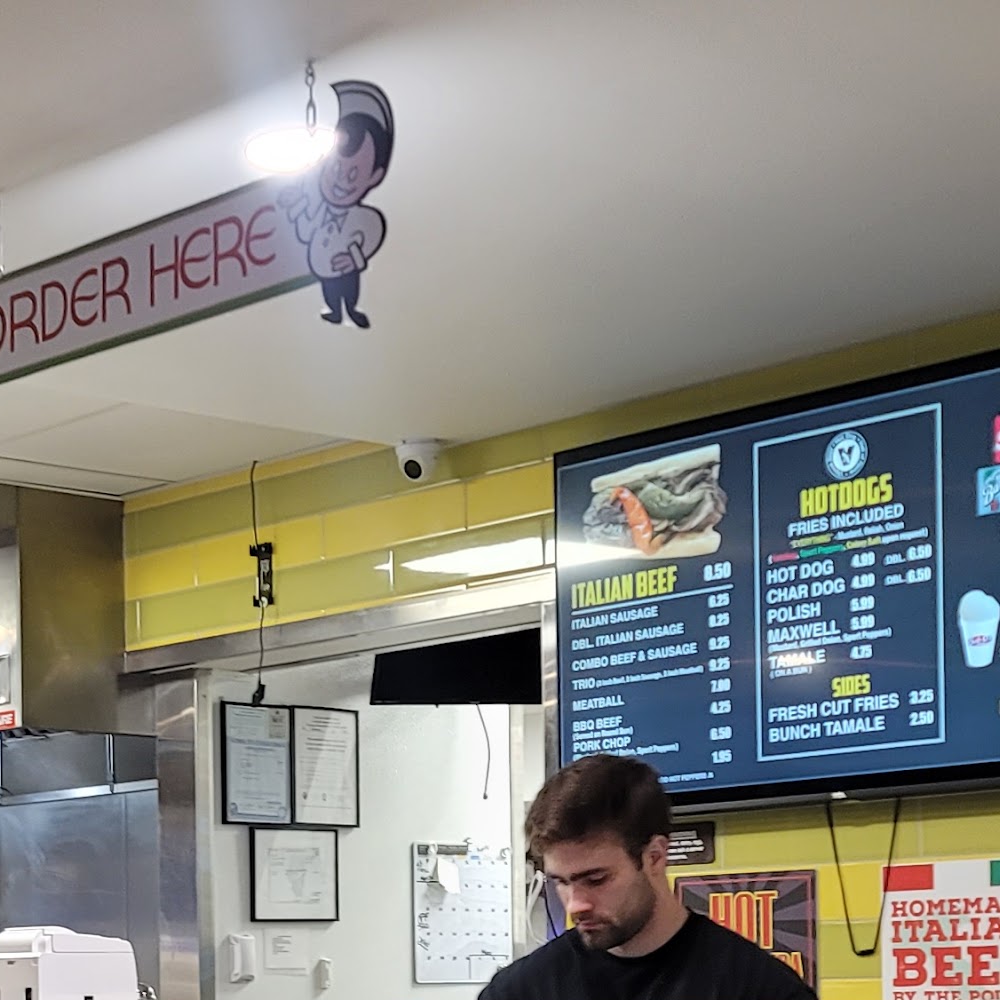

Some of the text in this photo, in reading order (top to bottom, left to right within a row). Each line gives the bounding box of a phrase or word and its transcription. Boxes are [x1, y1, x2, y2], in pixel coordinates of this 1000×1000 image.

[149, 205, 277, 308] HERE
[800, 472, 893, 518] HOTDOGS
[788, 503, 905, 538] FRIES INCLUDED
[766, 565, 798, 585] HOT
[799, 559, 835, 580] DOG
[571, 573, 634, 610] ITALIAN
[636, 565, 678, 598] BEEF
[766, 584, 809, 604] CHAR
[810, 577, 846, 598] DOG
[571, 614, 608, 630] ITALIAN
[610, 605, 659, 624] SAUSAGE
[766, 601, 822, 625] POLISH
[595, 630, 634, 647] ITALIAN
[635, 622, 684, 641] SAUSAGE
[767, 619, 841, 644] MAXWELL
[571, 655, 609, 671] COMBO
[610, 651, 637, 666] BEEF
[637, 650, 646, 662] &
[647, 642, 698, 660] SAUSAGE
[767, 649, 827, 670] TAMALE
[571, 677, 596, 690] TRIO
[831, 673, 871, 698] SIDES
[572, 694, 626, 712] MEATBALL
[768, 703, 818, 723] FRESH
[820, 699, 852, 718] CUT
[853, 692, 900, 713] FRIES
[572, 719, 595, 732] BBQ
[596, 715, 623, 730] BEEF
[769, 710, 935, 743] BUNCH TAMALE 2.50
[573, 740, 601, 753] PORK
[602, 736, 632, 750] CHOP
[891, 896, 1000, 917] HOMEMA
[709, 890, 779, 950] HOT
[891, 917, 1000, 943] ITALIA
[893, 945, 1000, 987] BEE
